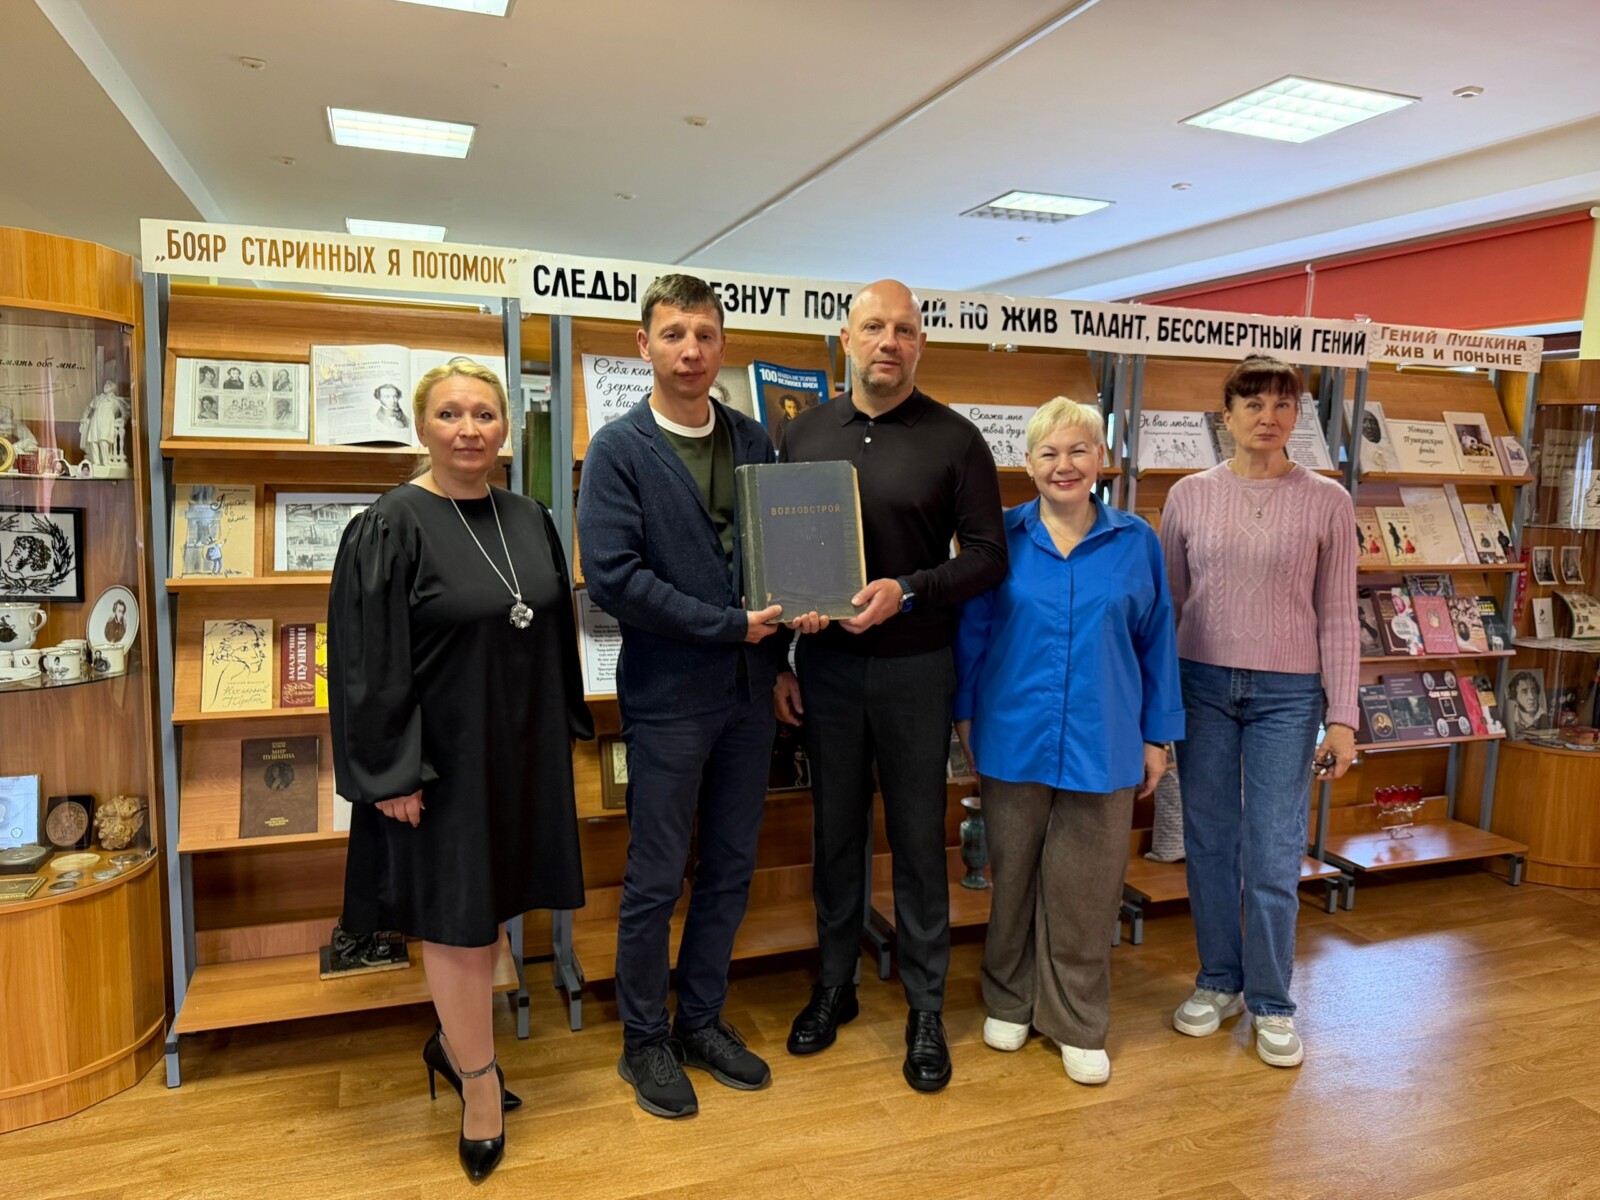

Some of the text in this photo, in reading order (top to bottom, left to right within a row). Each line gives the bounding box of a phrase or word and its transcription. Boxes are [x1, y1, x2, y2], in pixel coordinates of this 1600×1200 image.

[241, 236, 377, 275] СТАРИННЫХ
[387, 248, 401, 276] Я
[533, 264, 637, 304] СЛЕДЫ
[960, 300, 988, 330] НО
[1001, 305, 1058, 334] ЖИВ
[1070, 309, 1150, 344] ТАЛАНТ,
[1157, 316, 1302, 351] БЕССМЕРТНЫЙ
[1311, 328, 1367, 356] ГЕНИЙ
[1380, 326, 1528, 352] ГЕНИЙ ПУШКИНА
[0, 358, 33, 367] мять
[36, 356, 54, 368] обо
[1383, 344, 1523, 366] ЖИВ И ПОНЫНЕ
[593, 357, 654, 376] Себя как
[596, 375, 608, 390] в
[758, 367, 777, 384] 100
[602, 398, 613, 408] я
[969, 407, 1024, 421] Скажи мне
[1152, 414, 1168, 427] вас
[1169, 415, 1204, 429] любил!
[770, 503, 841, 517] ВОЛХОВСТРОЙ
[296, 627, 308, 682] ПУШКИН
